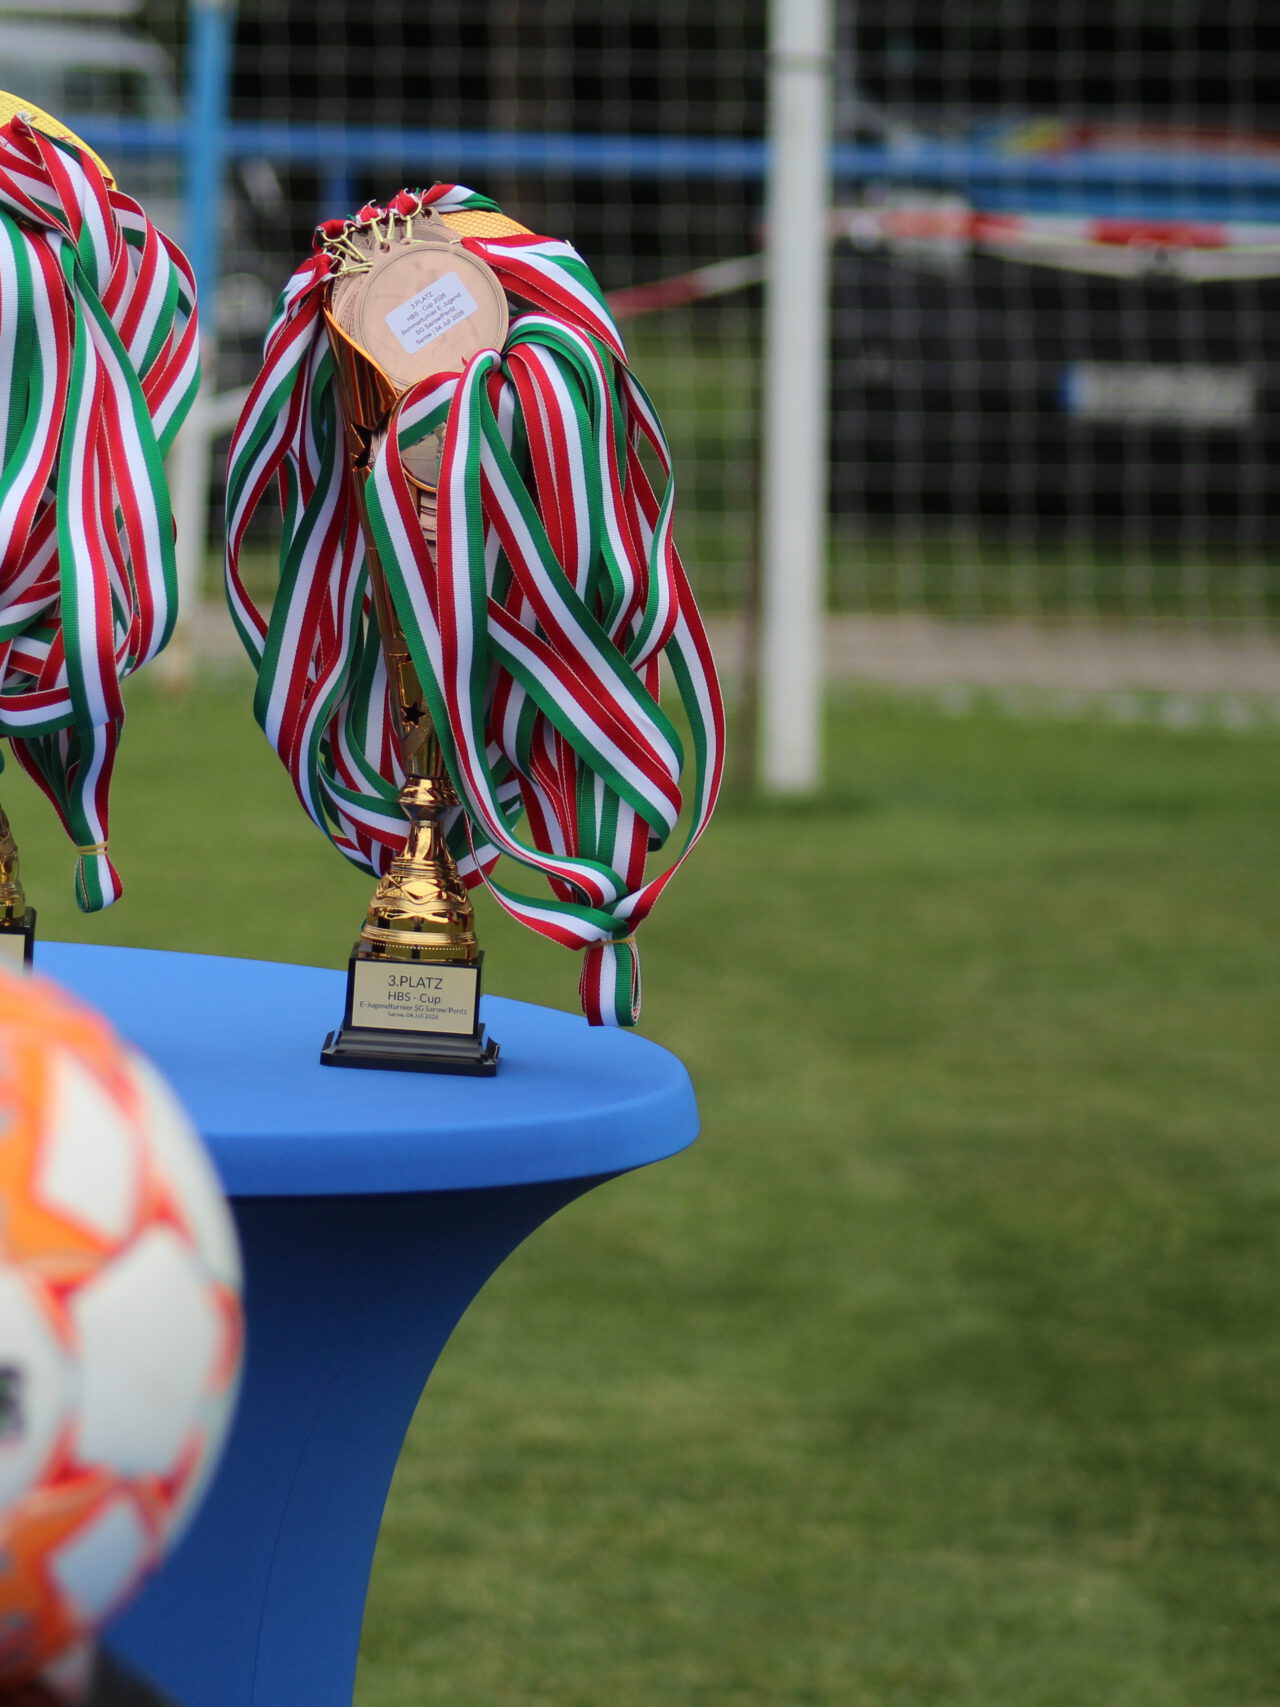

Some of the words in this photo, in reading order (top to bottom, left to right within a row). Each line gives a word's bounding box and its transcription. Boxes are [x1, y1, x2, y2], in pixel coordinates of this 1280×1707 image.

[422, 302, 433, 312] Cup
[388, 974, 443, 990] 3.PLATZ
[388, 991, 411, 1002] HBS
[419, 993, 441, 1005] Cup
[360, 1001, 413, 1011] E-Jugendturnier
